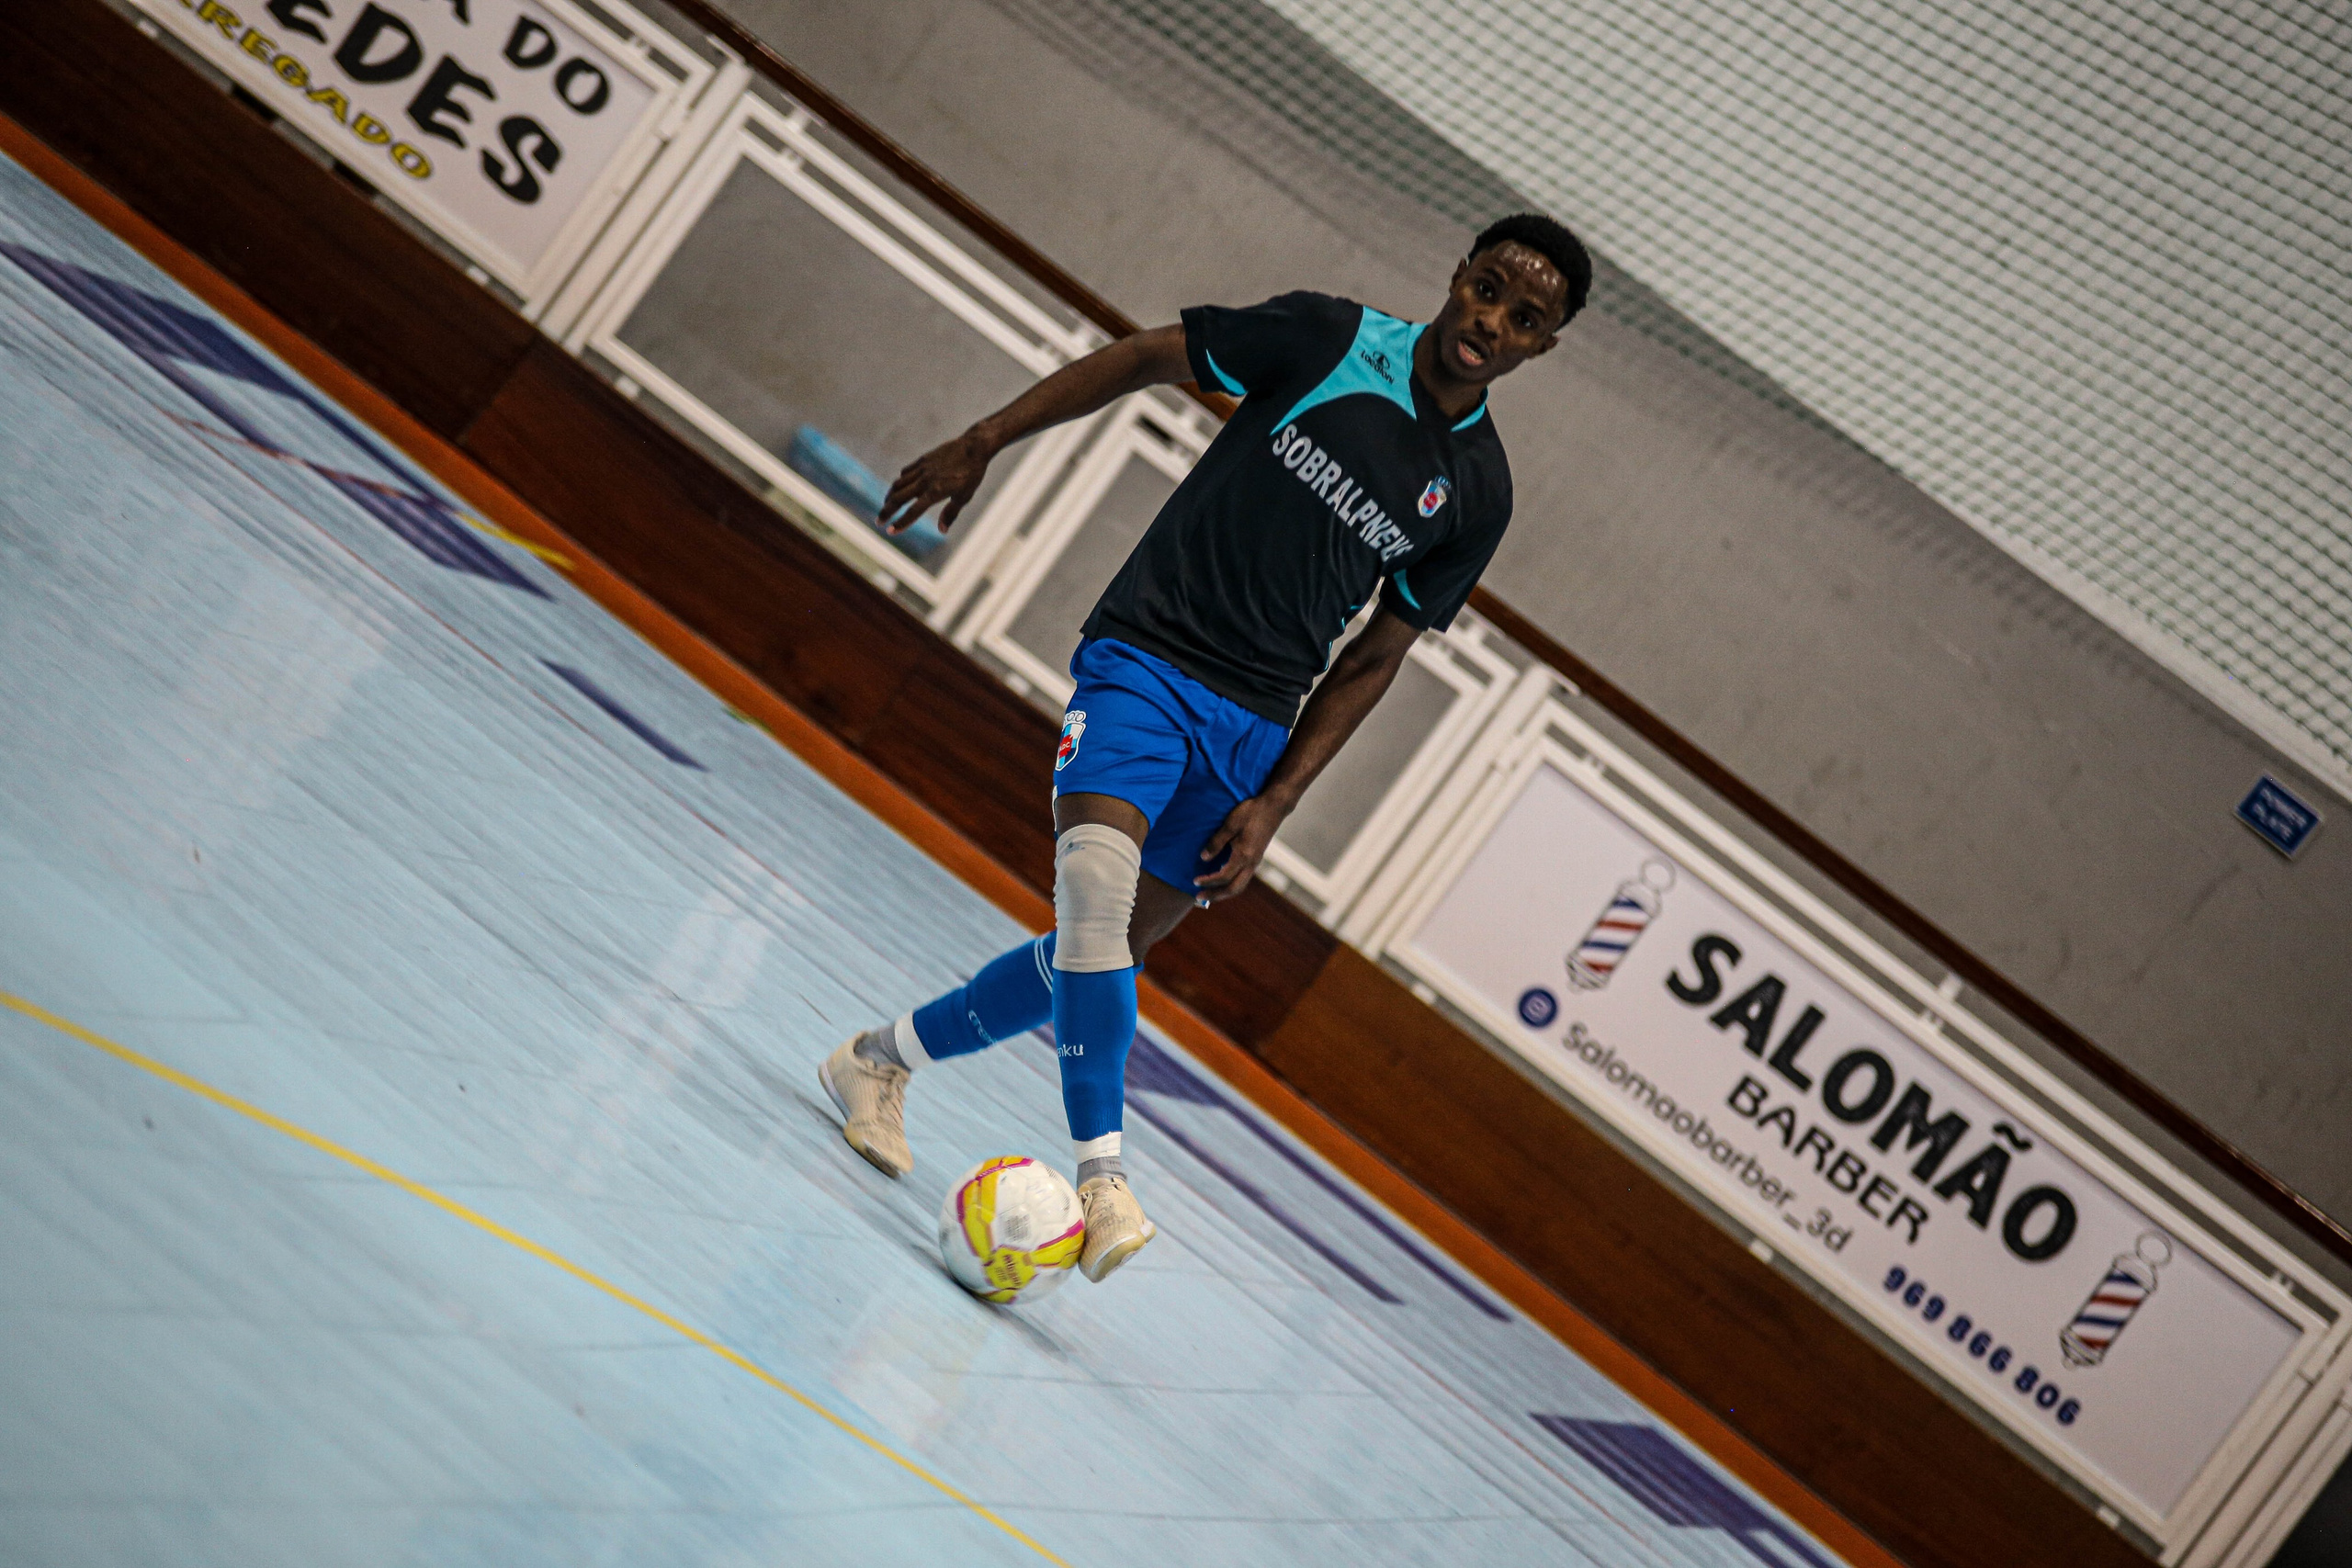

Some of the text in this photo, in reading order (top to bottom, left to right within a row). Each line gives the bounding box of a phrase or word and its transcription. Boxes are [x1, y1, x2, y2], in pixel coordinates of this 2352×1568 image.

[179, 0, 431, 178] REGADO
[502, 14, 611, 117] DO
[1562, 1021, 1853, 1253] Salomaobarber_3d
[1664, 932, 2080, 1266] SALOMÃO
[1725, 1074, 1930, 1247] BARBER
[1882, 1265, 2083, 1429] 969 866 806
